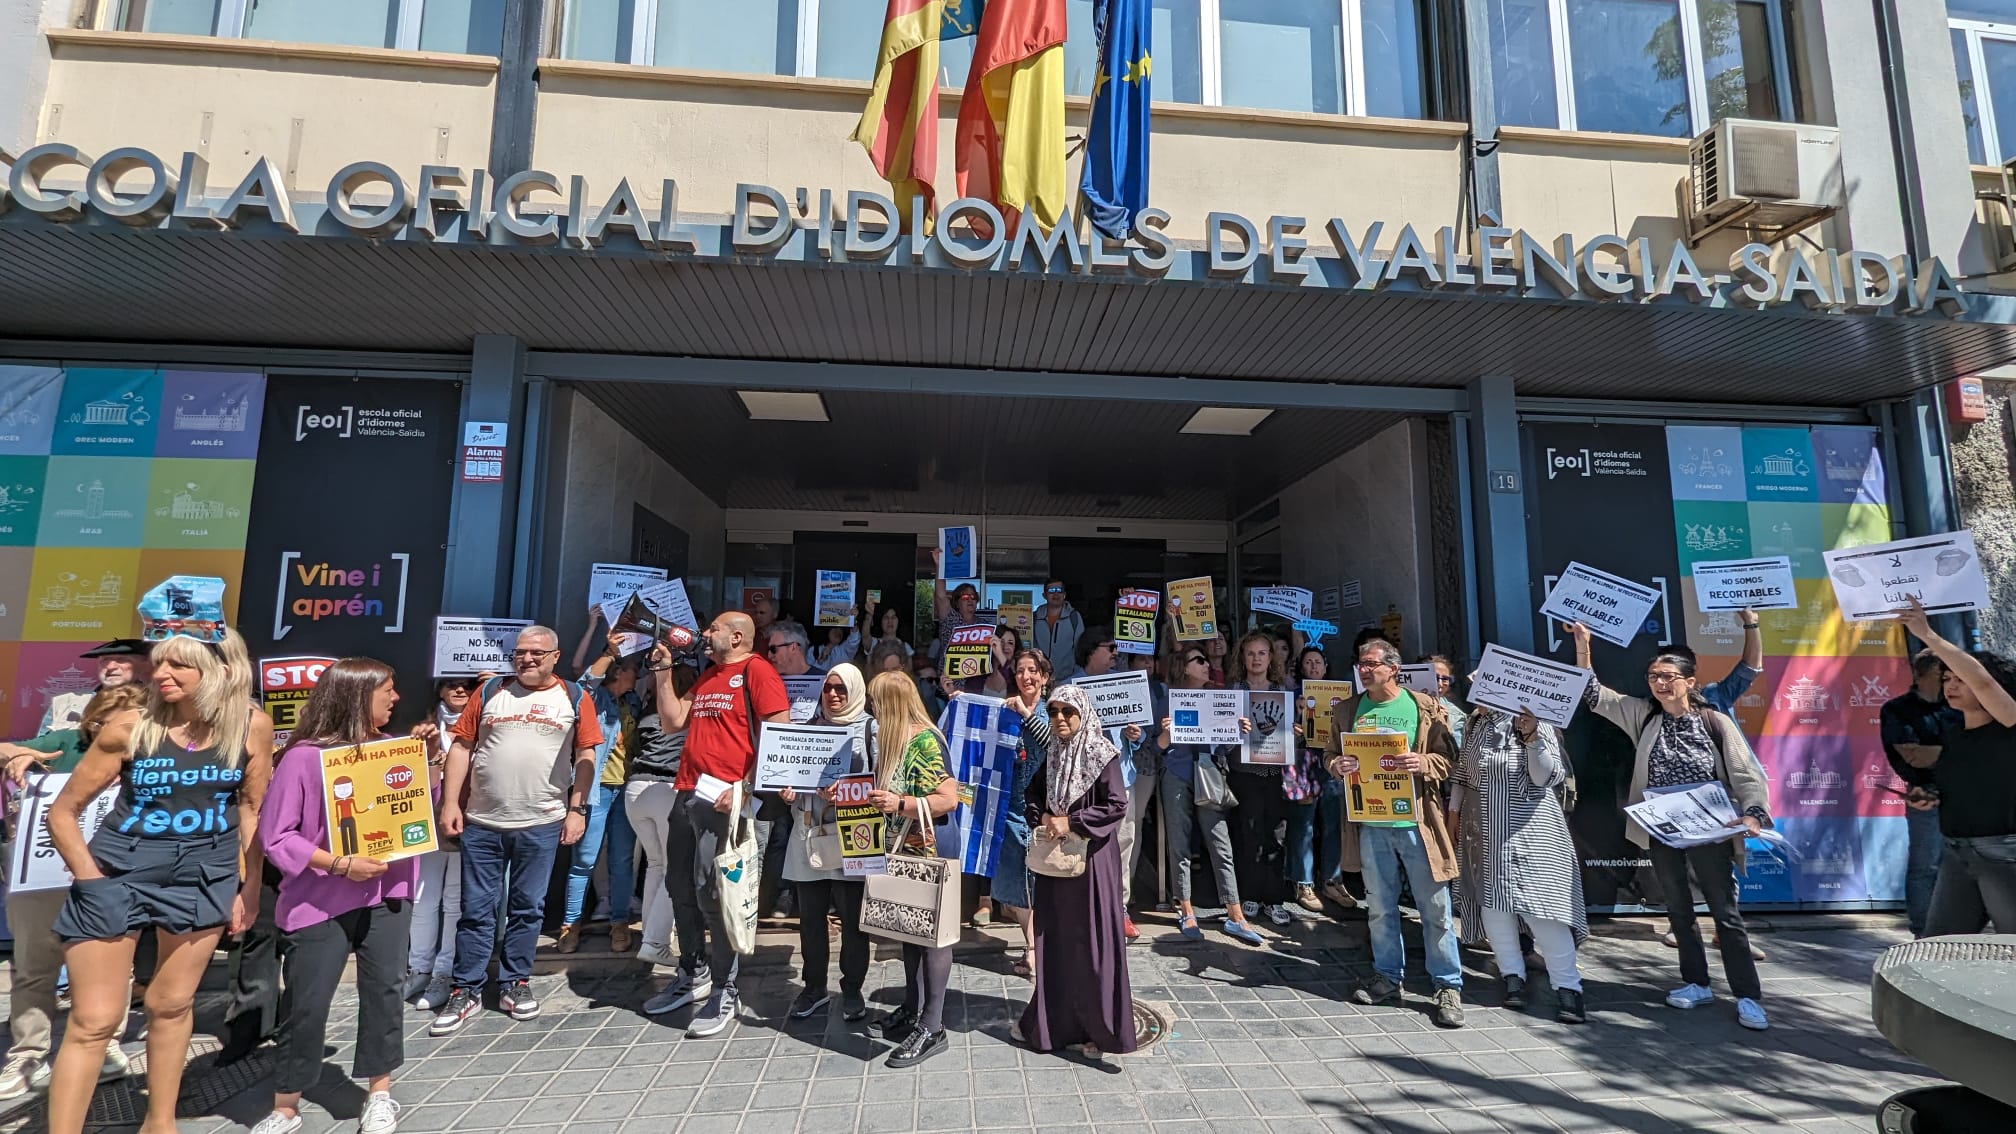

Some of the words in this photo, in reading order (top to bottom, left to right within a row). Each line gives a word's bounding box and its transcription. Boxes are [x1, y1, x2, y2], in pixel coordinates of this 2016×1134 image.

[4, 142, 299, 233] COLA
[326, 161, 697, 252] OFICIAL
[732, 183, 1174, 279] D'IDIOMES
[1205, 211, 1308, 286] DE
[358, 408, 390, 418] escola
[392, 409, 422, 418] oficial
[358, 418, 406, 428] d'idiomes
[466, 447, 502, 457] Alarma
[1593, 450, 1618, 458] escola
[1618, 452, 1642, 460] oficial
[1594, 459, 1630, 467] d'idiomes
[1498, 475, 1514, 489] 19
[1888, 554, 1902, 568] لا
[296, 562, 365, 586] Vine
[372, 563, 381, 586] i
[627, 582, 643, 590] SOM
[1735, 576, 1764, 585] SOMOS
[1266, 590, 1297, 598] SALVEM
[1582, 588, 1597, 600] NO
[1597, 594, 1618, 608] SOM
[1709, 587, 1782, 599] RECORTABLES
[1117, 594, 1157, 608] STOP
[292, 593, 383, 622] aprén
[1118, 608, 1154, 619] RETALLADES
[1562, 598, 1624, 627] RETALLABLES!
[952, 628, 992, 643] STOP
[468, 638, 482, 648] NO
[484, 639, 504, 648] SOM
[948, 645, 988, 653] RETALLADES
[452, 653, 514, 662] RETALLABLES
[1500, 660, 1540, 676] ENSENYAMENT
[266, 664, 328, 686] STO
[1504, 668, 1522, 678] PÚBLIC
[1534, 678, 1560, 688] QUALITAT
[1482, 672, 1494, 682] NO
[1502, 678, 1518, 690] LES
[1518, 683, 1572, 704] RETALLADES
[268, 690, 311, 700] RETAL
[712, 693, 734, 701] servei
[1106, 692, 1130, 700] SOMOS
[1096, 704, 1143, 717] CORTABLES
[1382, 739, 1406, 750] PROU!
[326, 758, 342, 768] JA
[370, 750, 387, 760] HA
[390, 742, 424, 757] PROU!
[766, 754, 778, 762] NO
[779, 755, 785, 763] A
[785, 755, 800, 764] LOS
[802, 756, 842, 766] RECORTES
[135, 758, 175, 768] som
[386, 770, 412, 784] STOP
[134, 786, 172, 796] som
[836, 782, 872, 802] STOP
[1384, 782, 1400, 790] EOI
[376, 788, 424, 805] RETALLADES
[390, 800, 413, 815] EOI
[368, 838, 394, 850] STEPV
